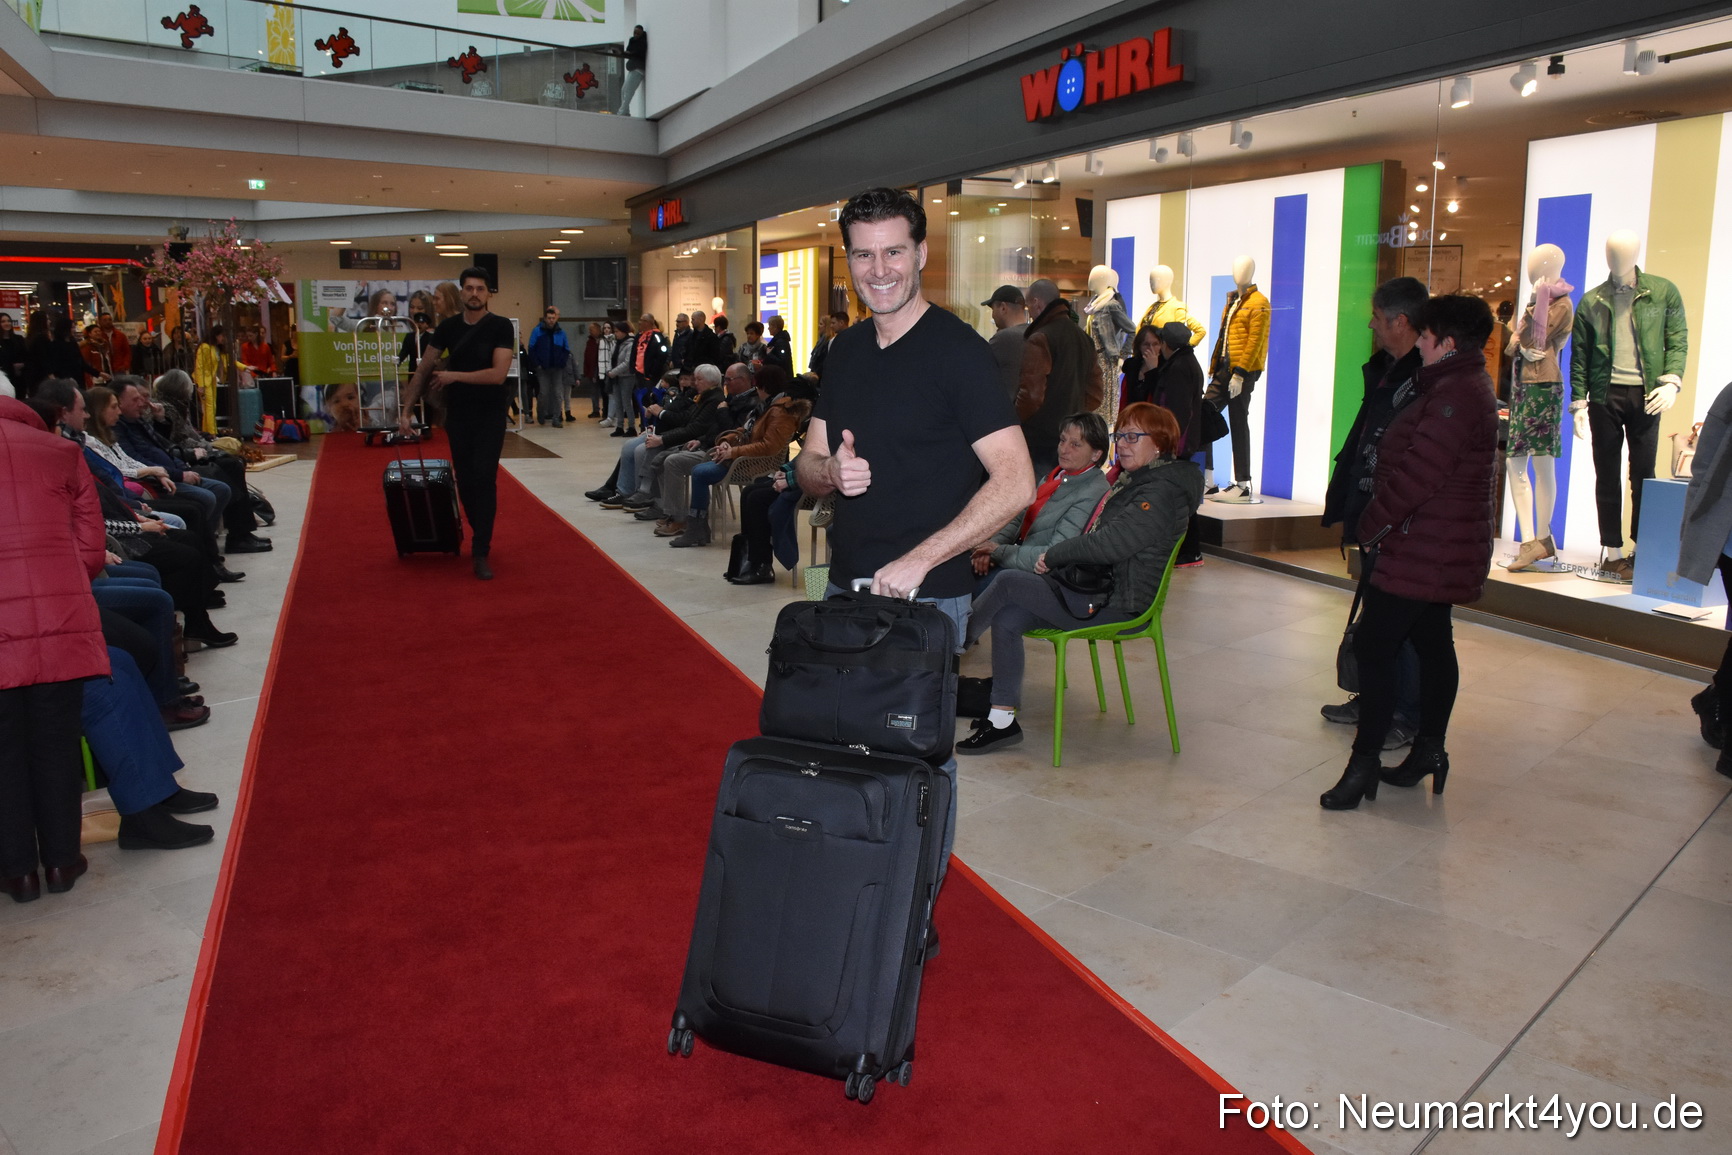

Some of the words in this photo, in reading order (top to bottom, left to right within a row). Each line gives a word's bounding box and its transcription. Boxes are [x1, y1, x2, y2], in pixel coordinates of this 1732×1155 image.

[1020, 27, 1184, 123] WÖHRL
[649, 198, 684, 232] WÖHRL
[333, 341, 354, 351] Von
[357, 340, 403, 352] Shoppn
[1560, 562, 1589, 575] GERRY
[1590, 568, 1622, 581] WEBER
